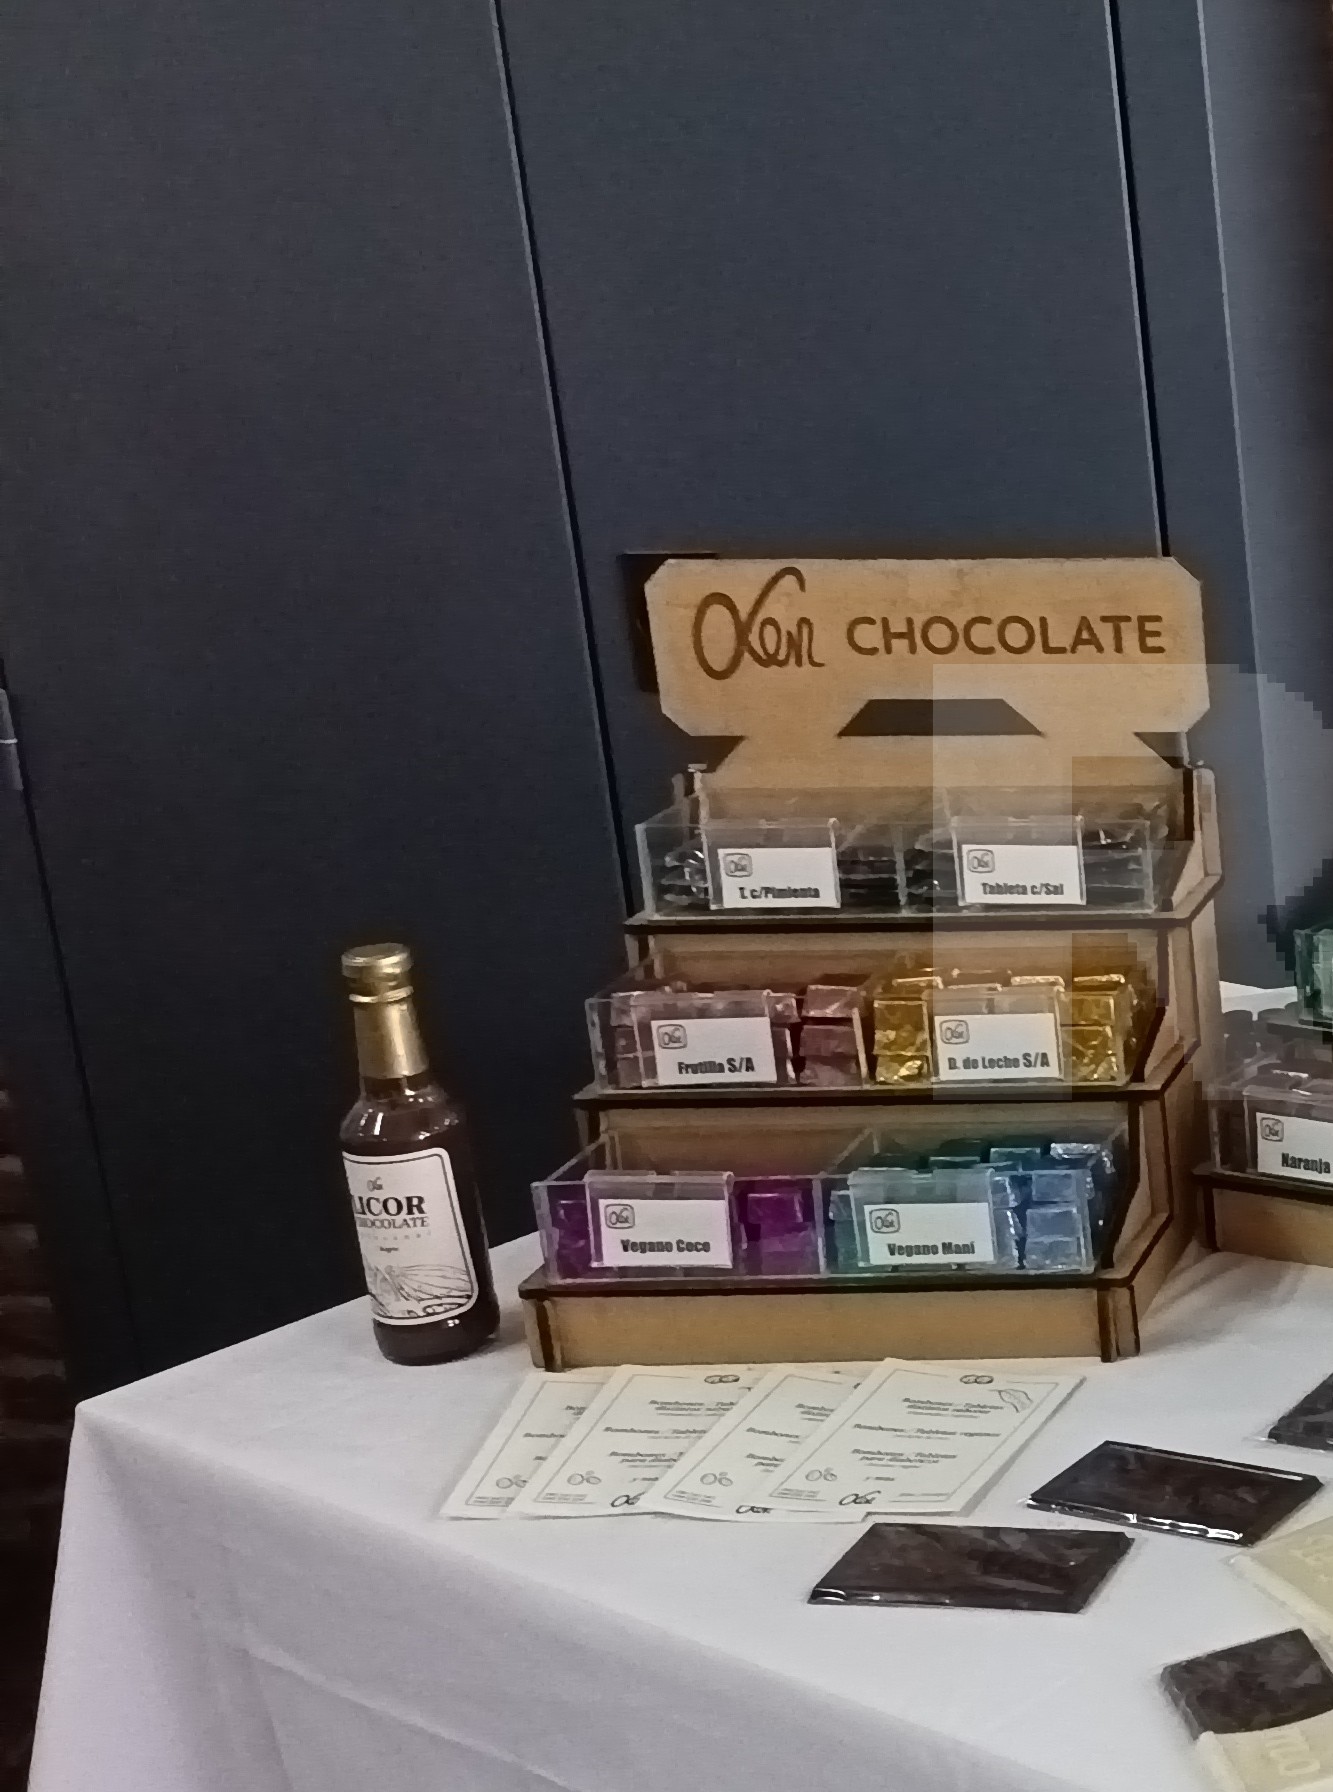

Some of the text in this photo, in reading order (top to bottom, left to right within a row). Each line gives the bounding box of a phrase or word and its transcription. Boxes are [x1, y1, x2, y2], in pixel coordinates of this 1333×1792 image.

[846, 614, 1166, 656] CHOCOLATE
[726, 1056, 757, 1074] S/A
[1022, 1051, 1051, 1069] S/A
[1281, 1152, 1332, 1175] Naranja
[620, 1238, 712, 1255] Vegano Coco
[886, 1242, 940, 1258] Vegano
